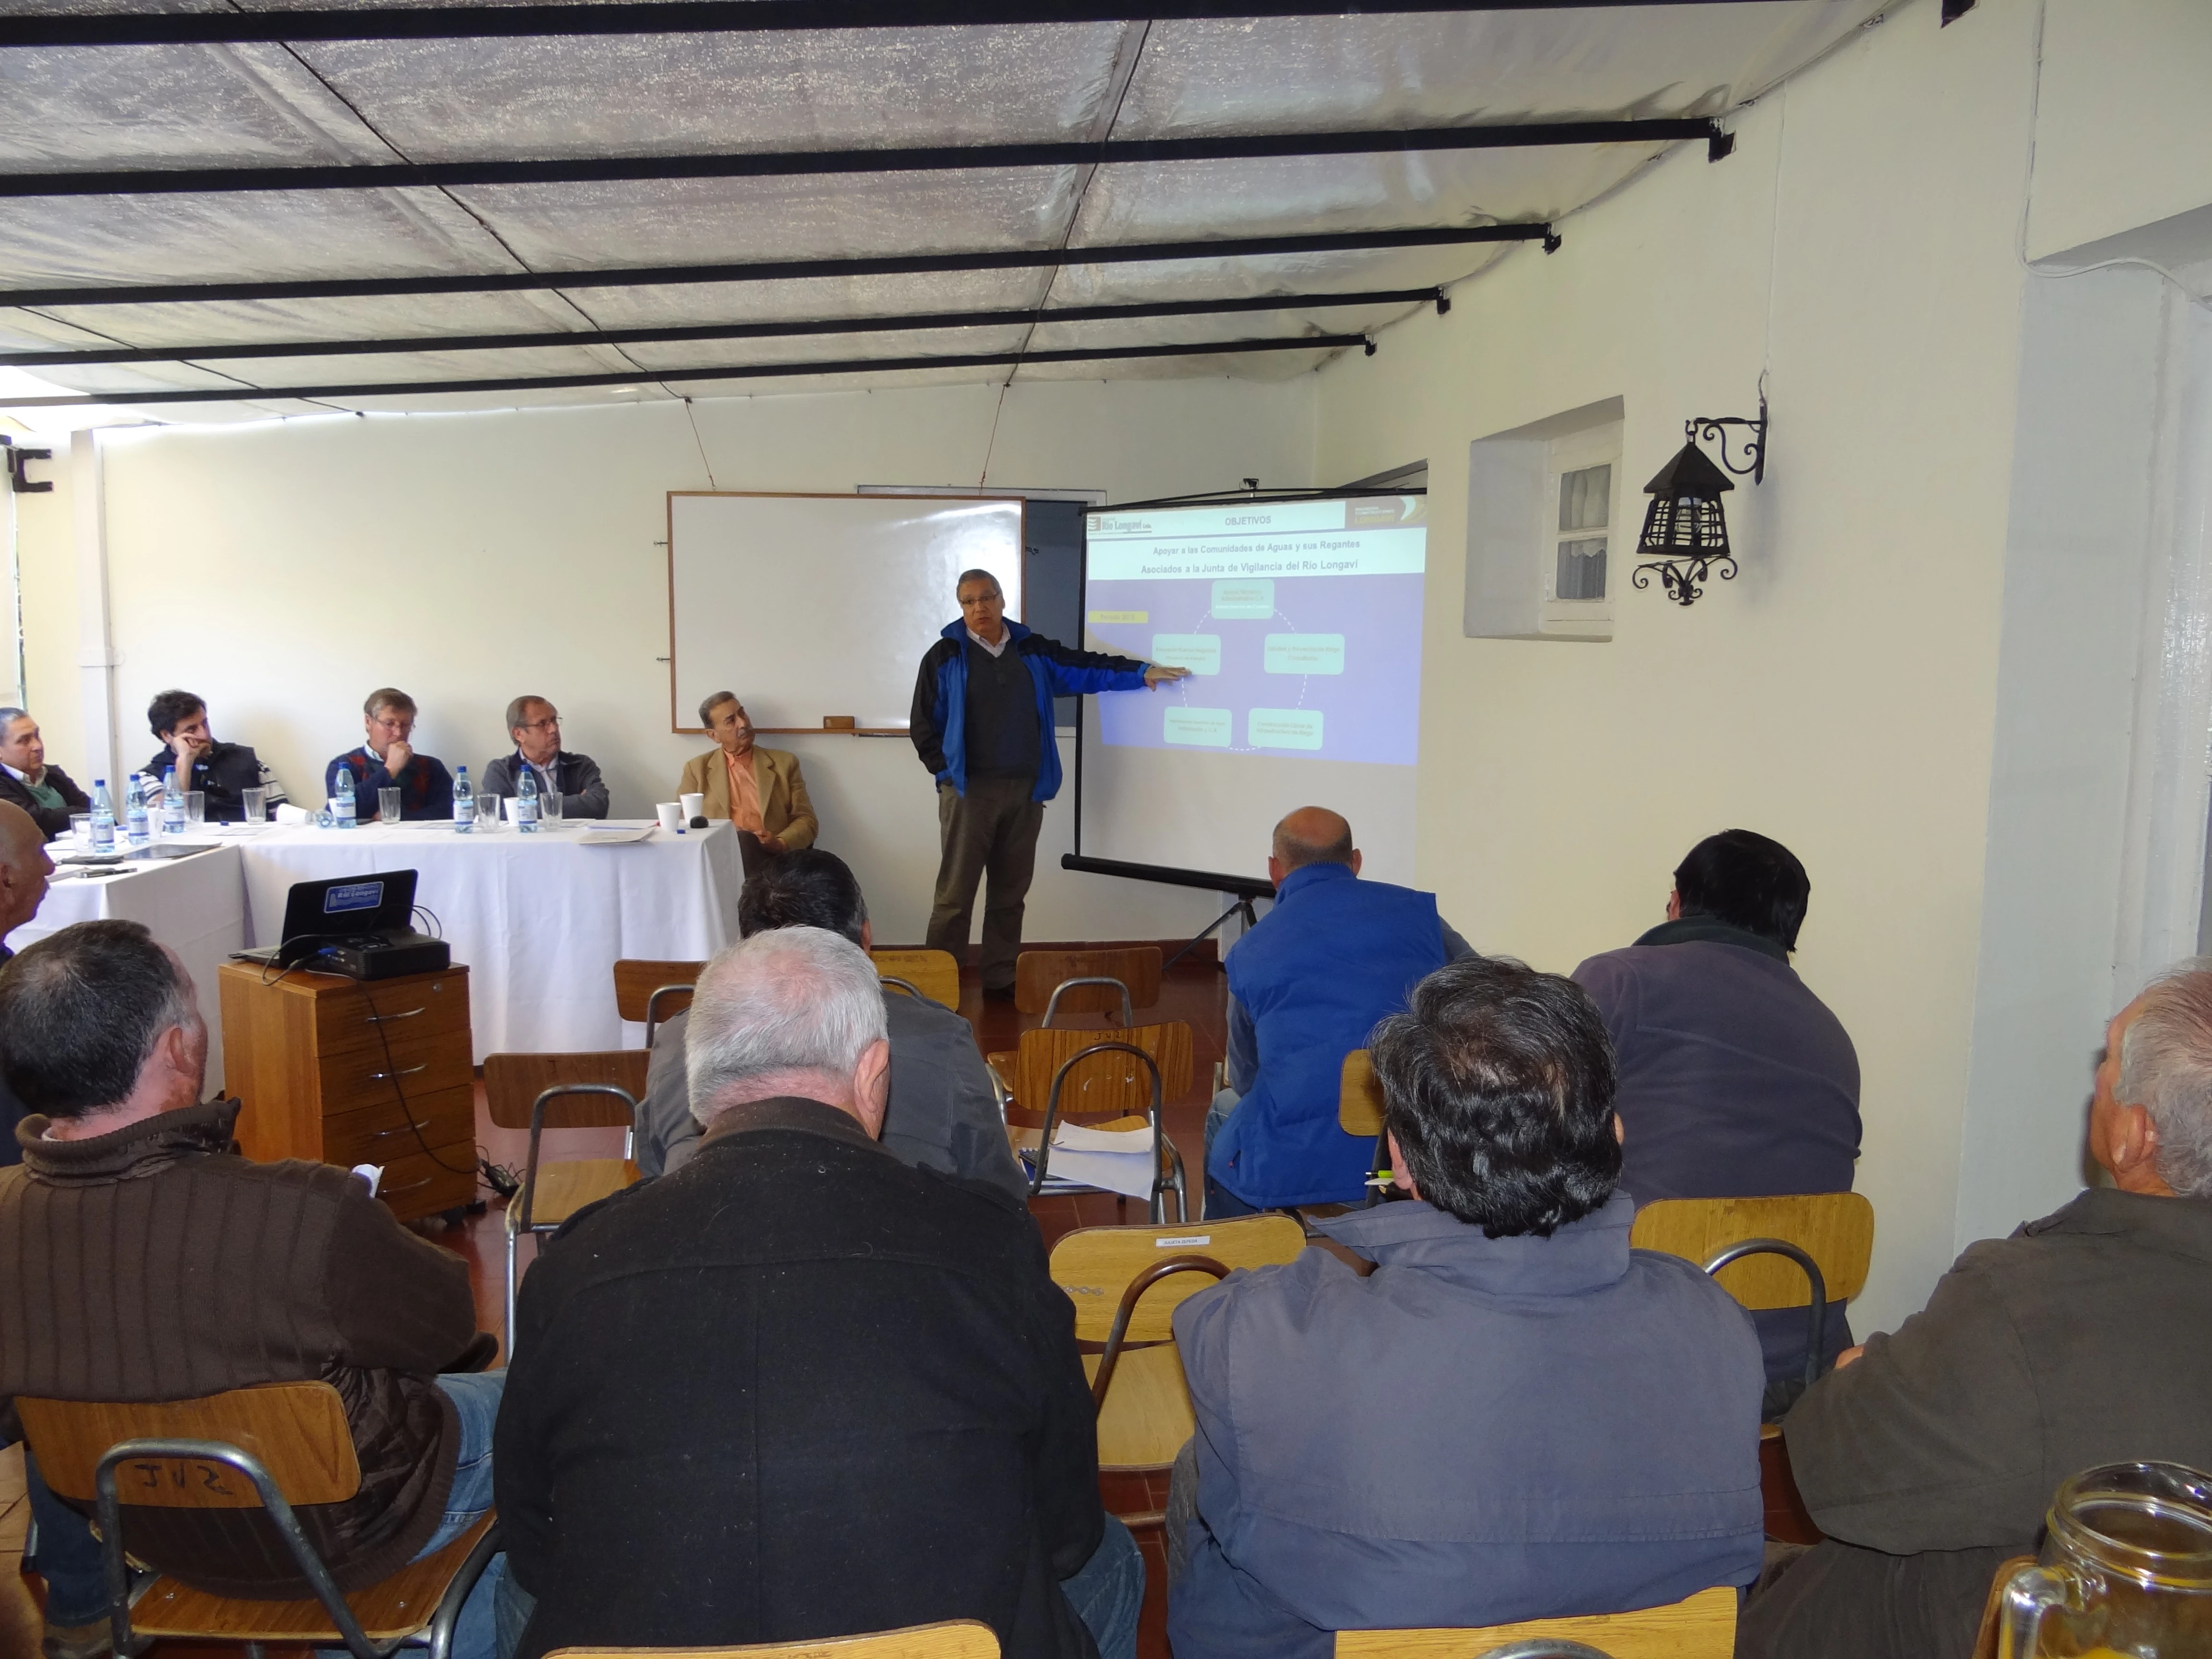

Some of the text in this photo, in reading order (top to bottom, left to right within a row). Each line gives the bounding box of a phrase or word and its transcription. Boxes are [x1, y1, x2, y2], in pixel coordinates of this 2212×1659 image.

[1225, 516, 1271, 525] OBJETIVOS
[1153, 547, 1178, 556] Apoyar
[1201, 544, 1253, 553] Comunidades
[1256, 543, 1265, 552] de
[1267, 543, 1293, 553] Aguas
[1296, 543, 1300, 552] y
[1320, 540, 1360, 551] Regantes
[1141, 565, 1182, 574] Asociados
[1202, 564, 1225, 572] Junta
[1228, 564, 1238, 572] de
[1241, 562, 1282, 573] Vigilancia
[1286, 562, 1299, 570] del
[1302, 561, 1317, 570] Río
[1321, 559, 1358, 571] Longaví
